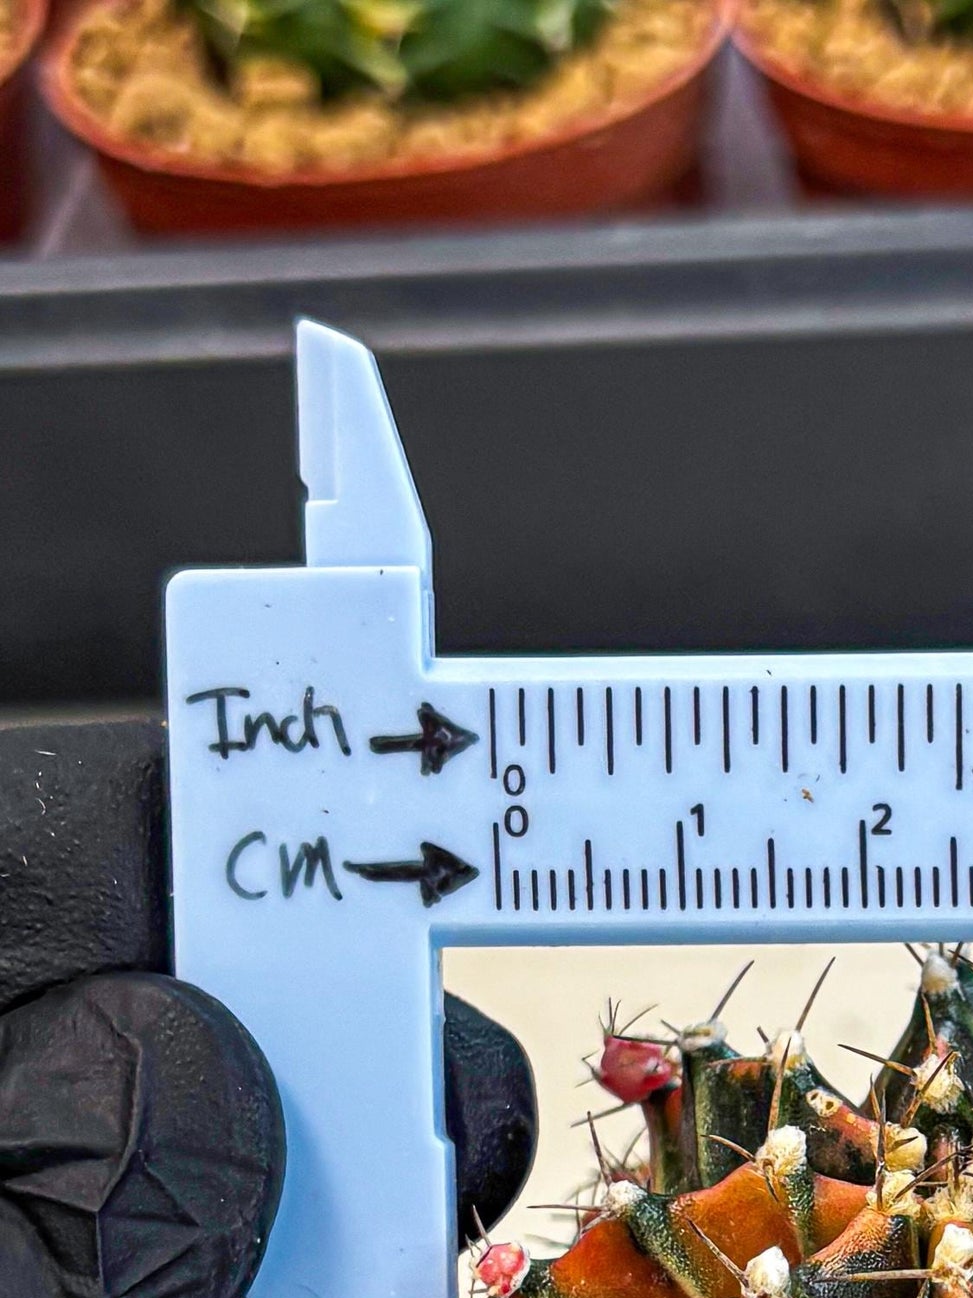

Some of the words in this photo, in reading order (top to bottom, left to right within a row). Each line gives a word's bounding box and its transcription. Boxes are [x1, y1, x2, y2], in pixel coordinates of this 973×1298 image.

[185, 685, 352, 761] Inch
[502, 763, 527, 797] 0
[503, 804, 530, 838] 0
[689, 802, 705, 837] 1
[870, 802, 893, 836] 2
